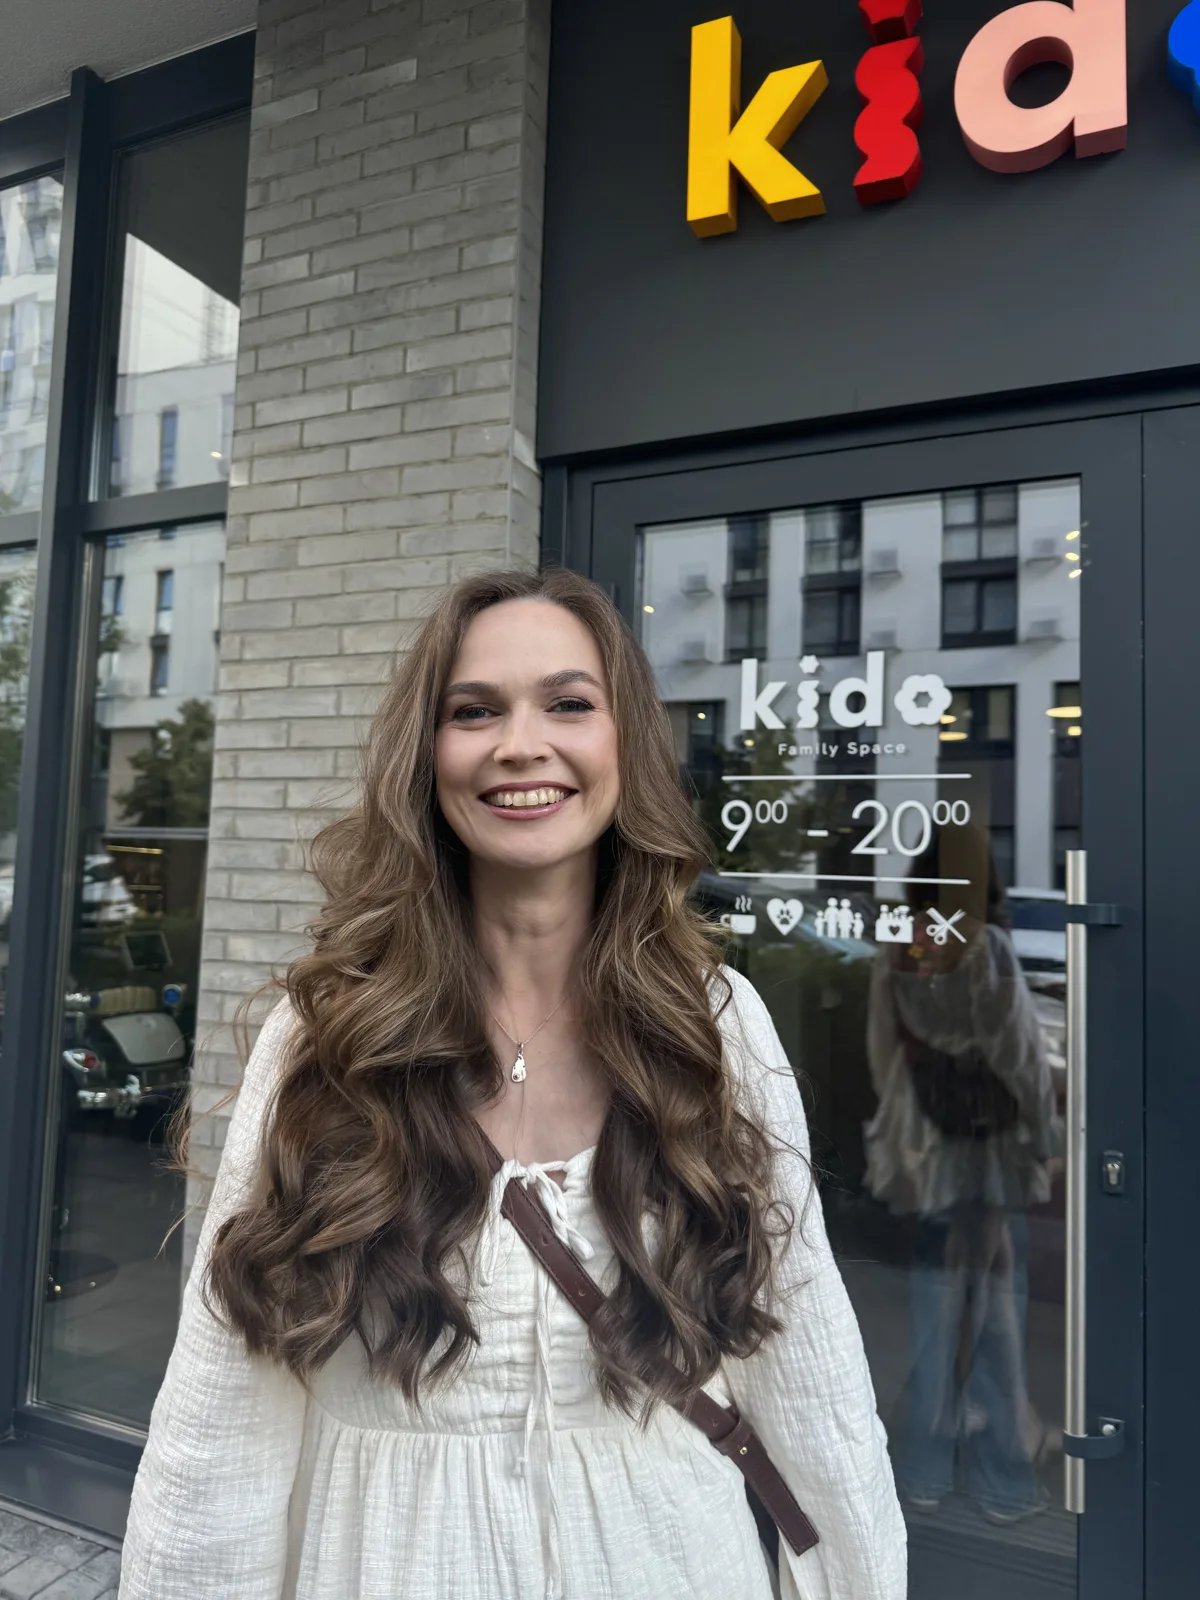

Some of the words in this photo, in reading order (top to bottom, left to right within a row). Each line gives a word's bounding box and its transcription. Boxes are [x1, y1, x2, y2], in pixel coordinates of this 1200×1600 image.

[740, 651, 953, 730] kido
[778, 743, 839, 758] Family
[847, 741, 906, 757] Space
